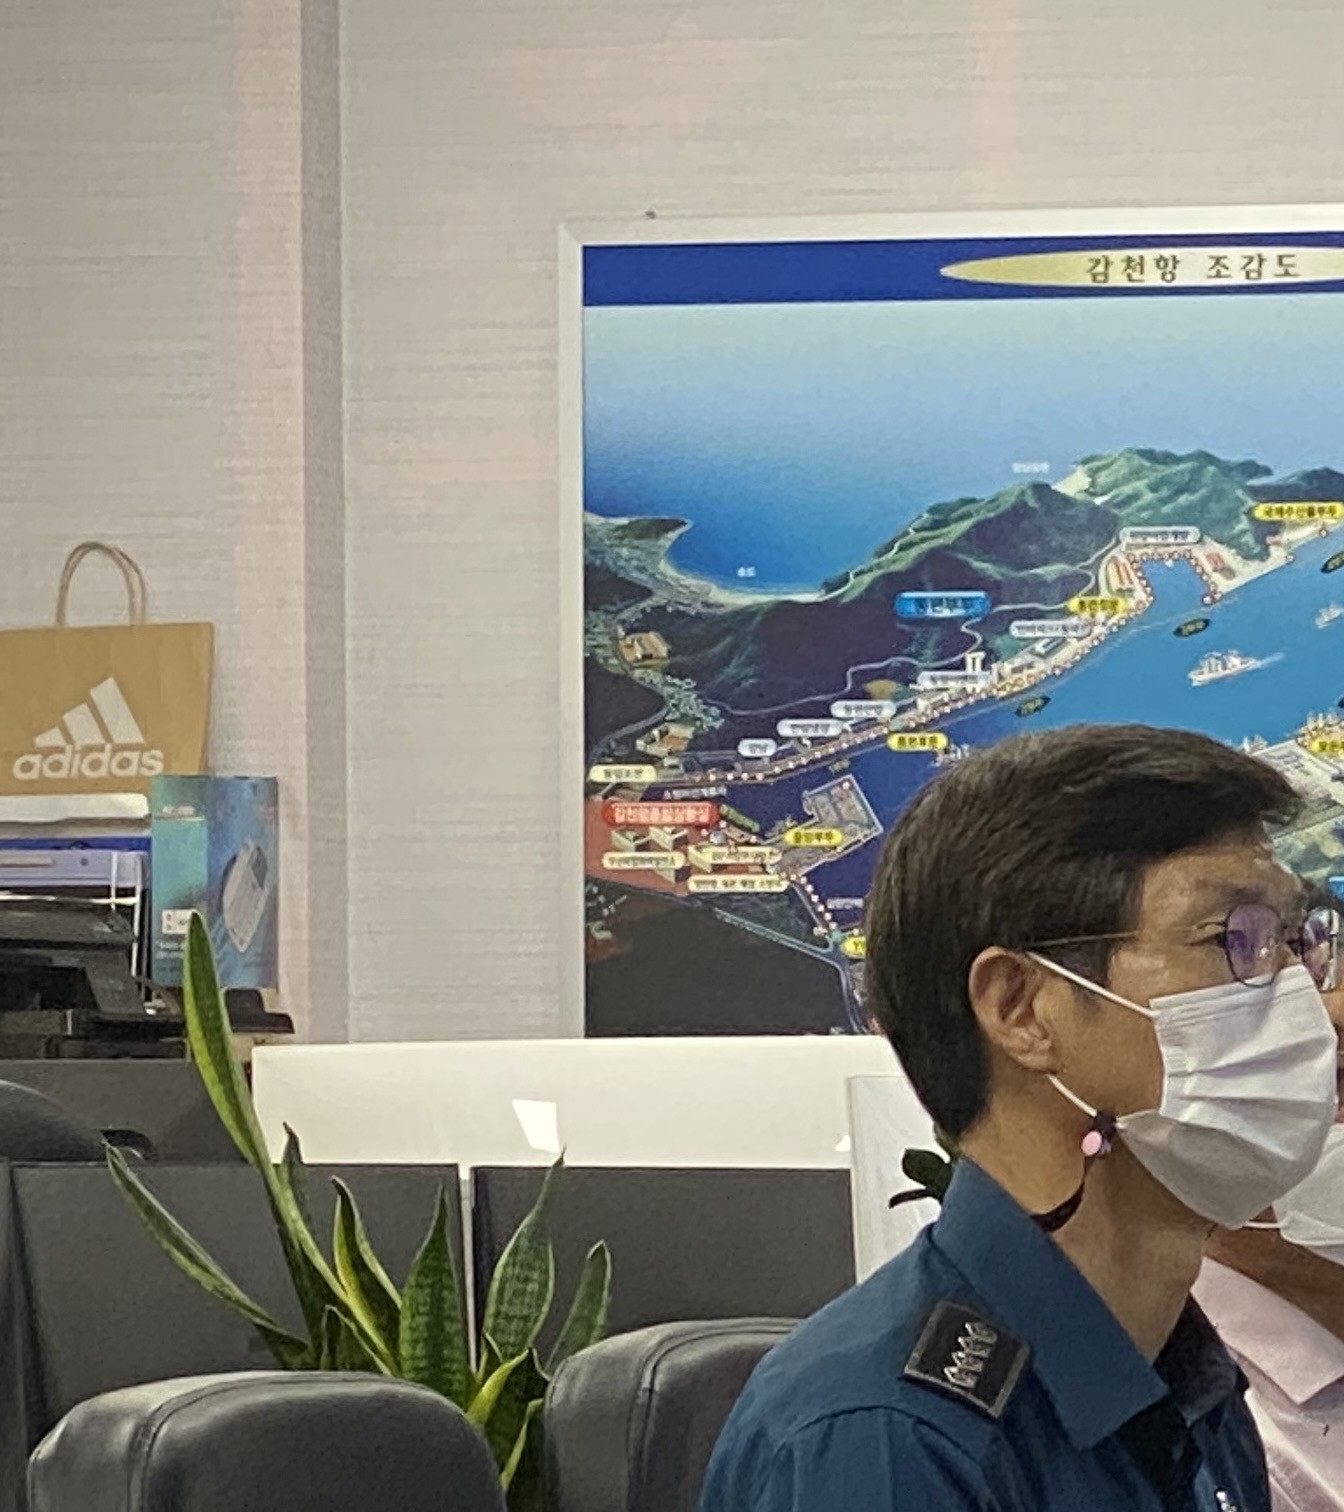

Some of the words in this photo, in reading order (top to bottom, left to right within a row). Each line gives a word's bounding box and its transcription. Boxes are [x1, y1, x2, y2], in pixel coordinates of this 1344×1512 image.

[1087, 254, 1181, 283] 감천항
[1206, 252, 1300, 281] 조감도
[13, 744, 164, 780] adidas
